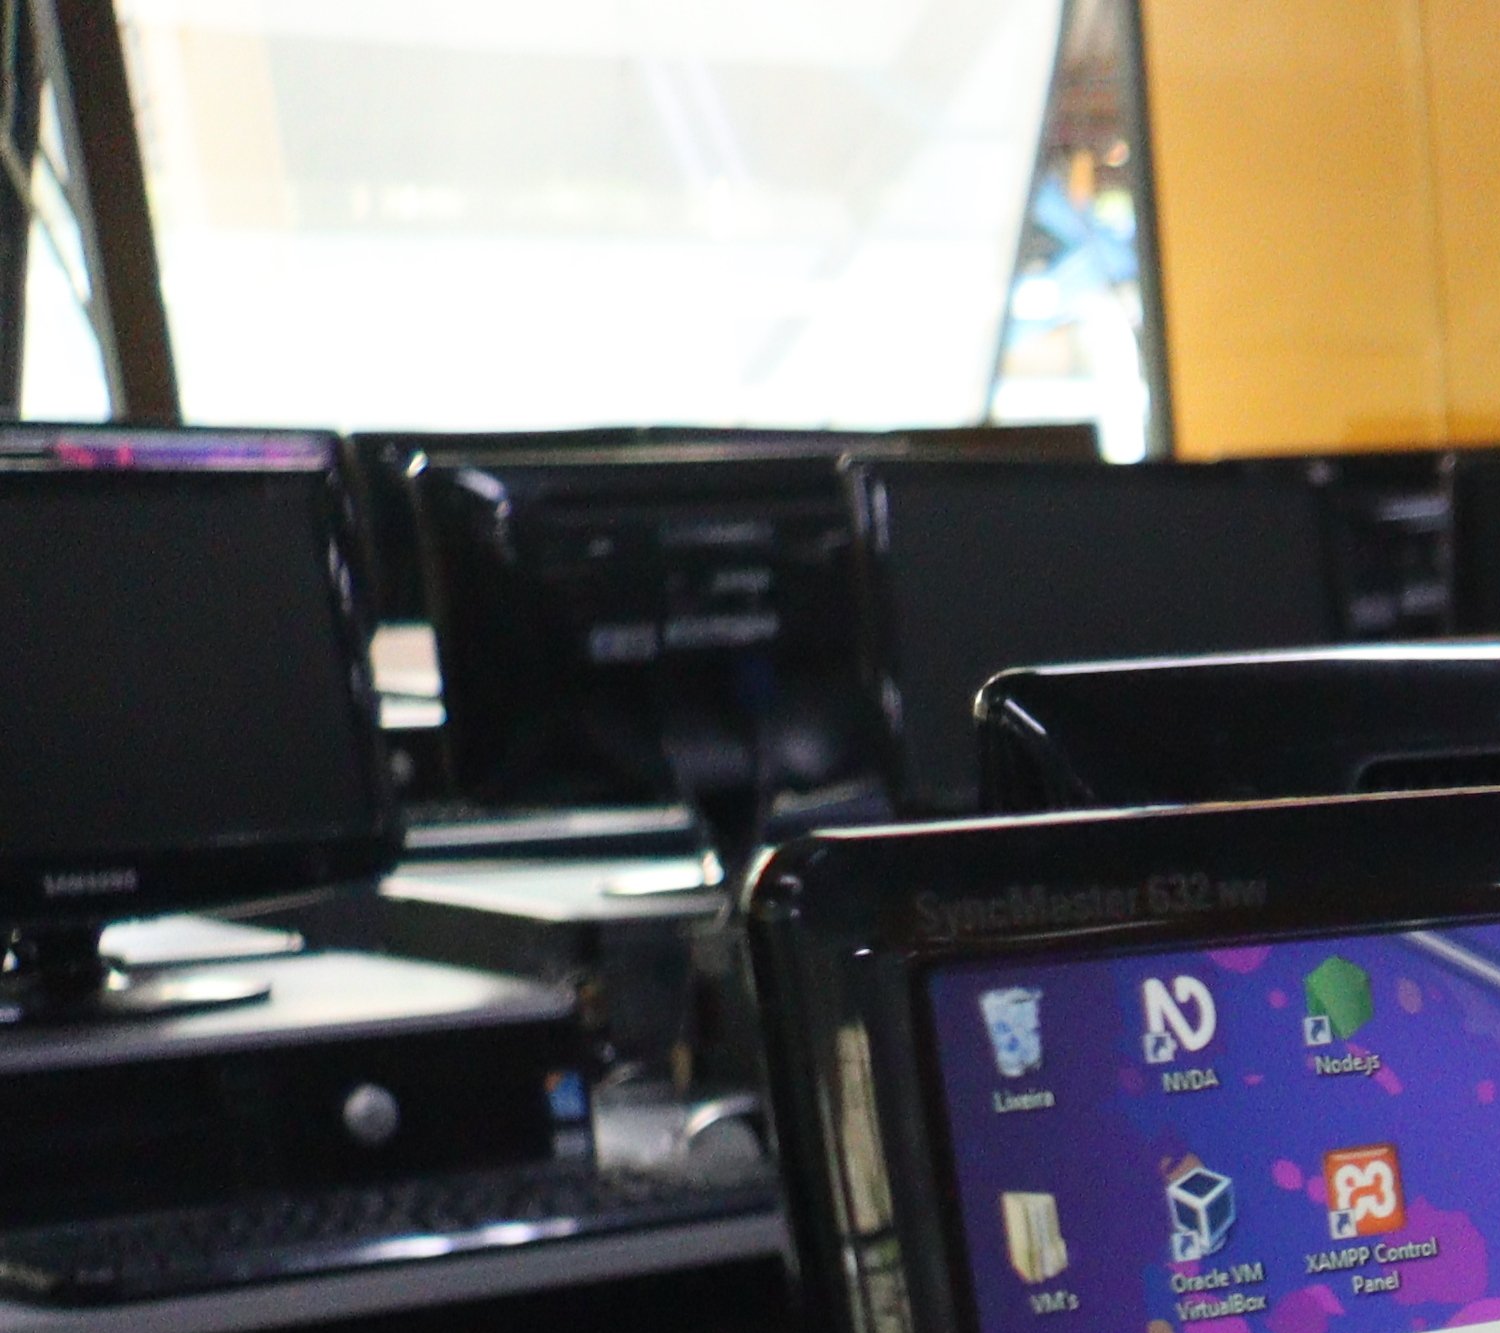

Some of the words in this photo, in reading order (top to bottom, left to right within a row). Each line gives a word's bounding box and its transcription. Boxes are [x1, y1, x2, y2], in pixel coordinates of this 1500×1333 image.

[1315, 1053, 1382, 1078] Node.js
[1163, 1071, 1220, 1093] NVDA
[1306, 1246, 1371, 1274] XAMPP
[1374, 1238, 1438, 1265] Control
[1170, 1268, 1228, 1292] Oracle
[1231, 1262, 1264, 1285] VM
[1351, 1273, 1401, 1294] Panel
[1175, 1291, 1267, 1322] VirtualBox
